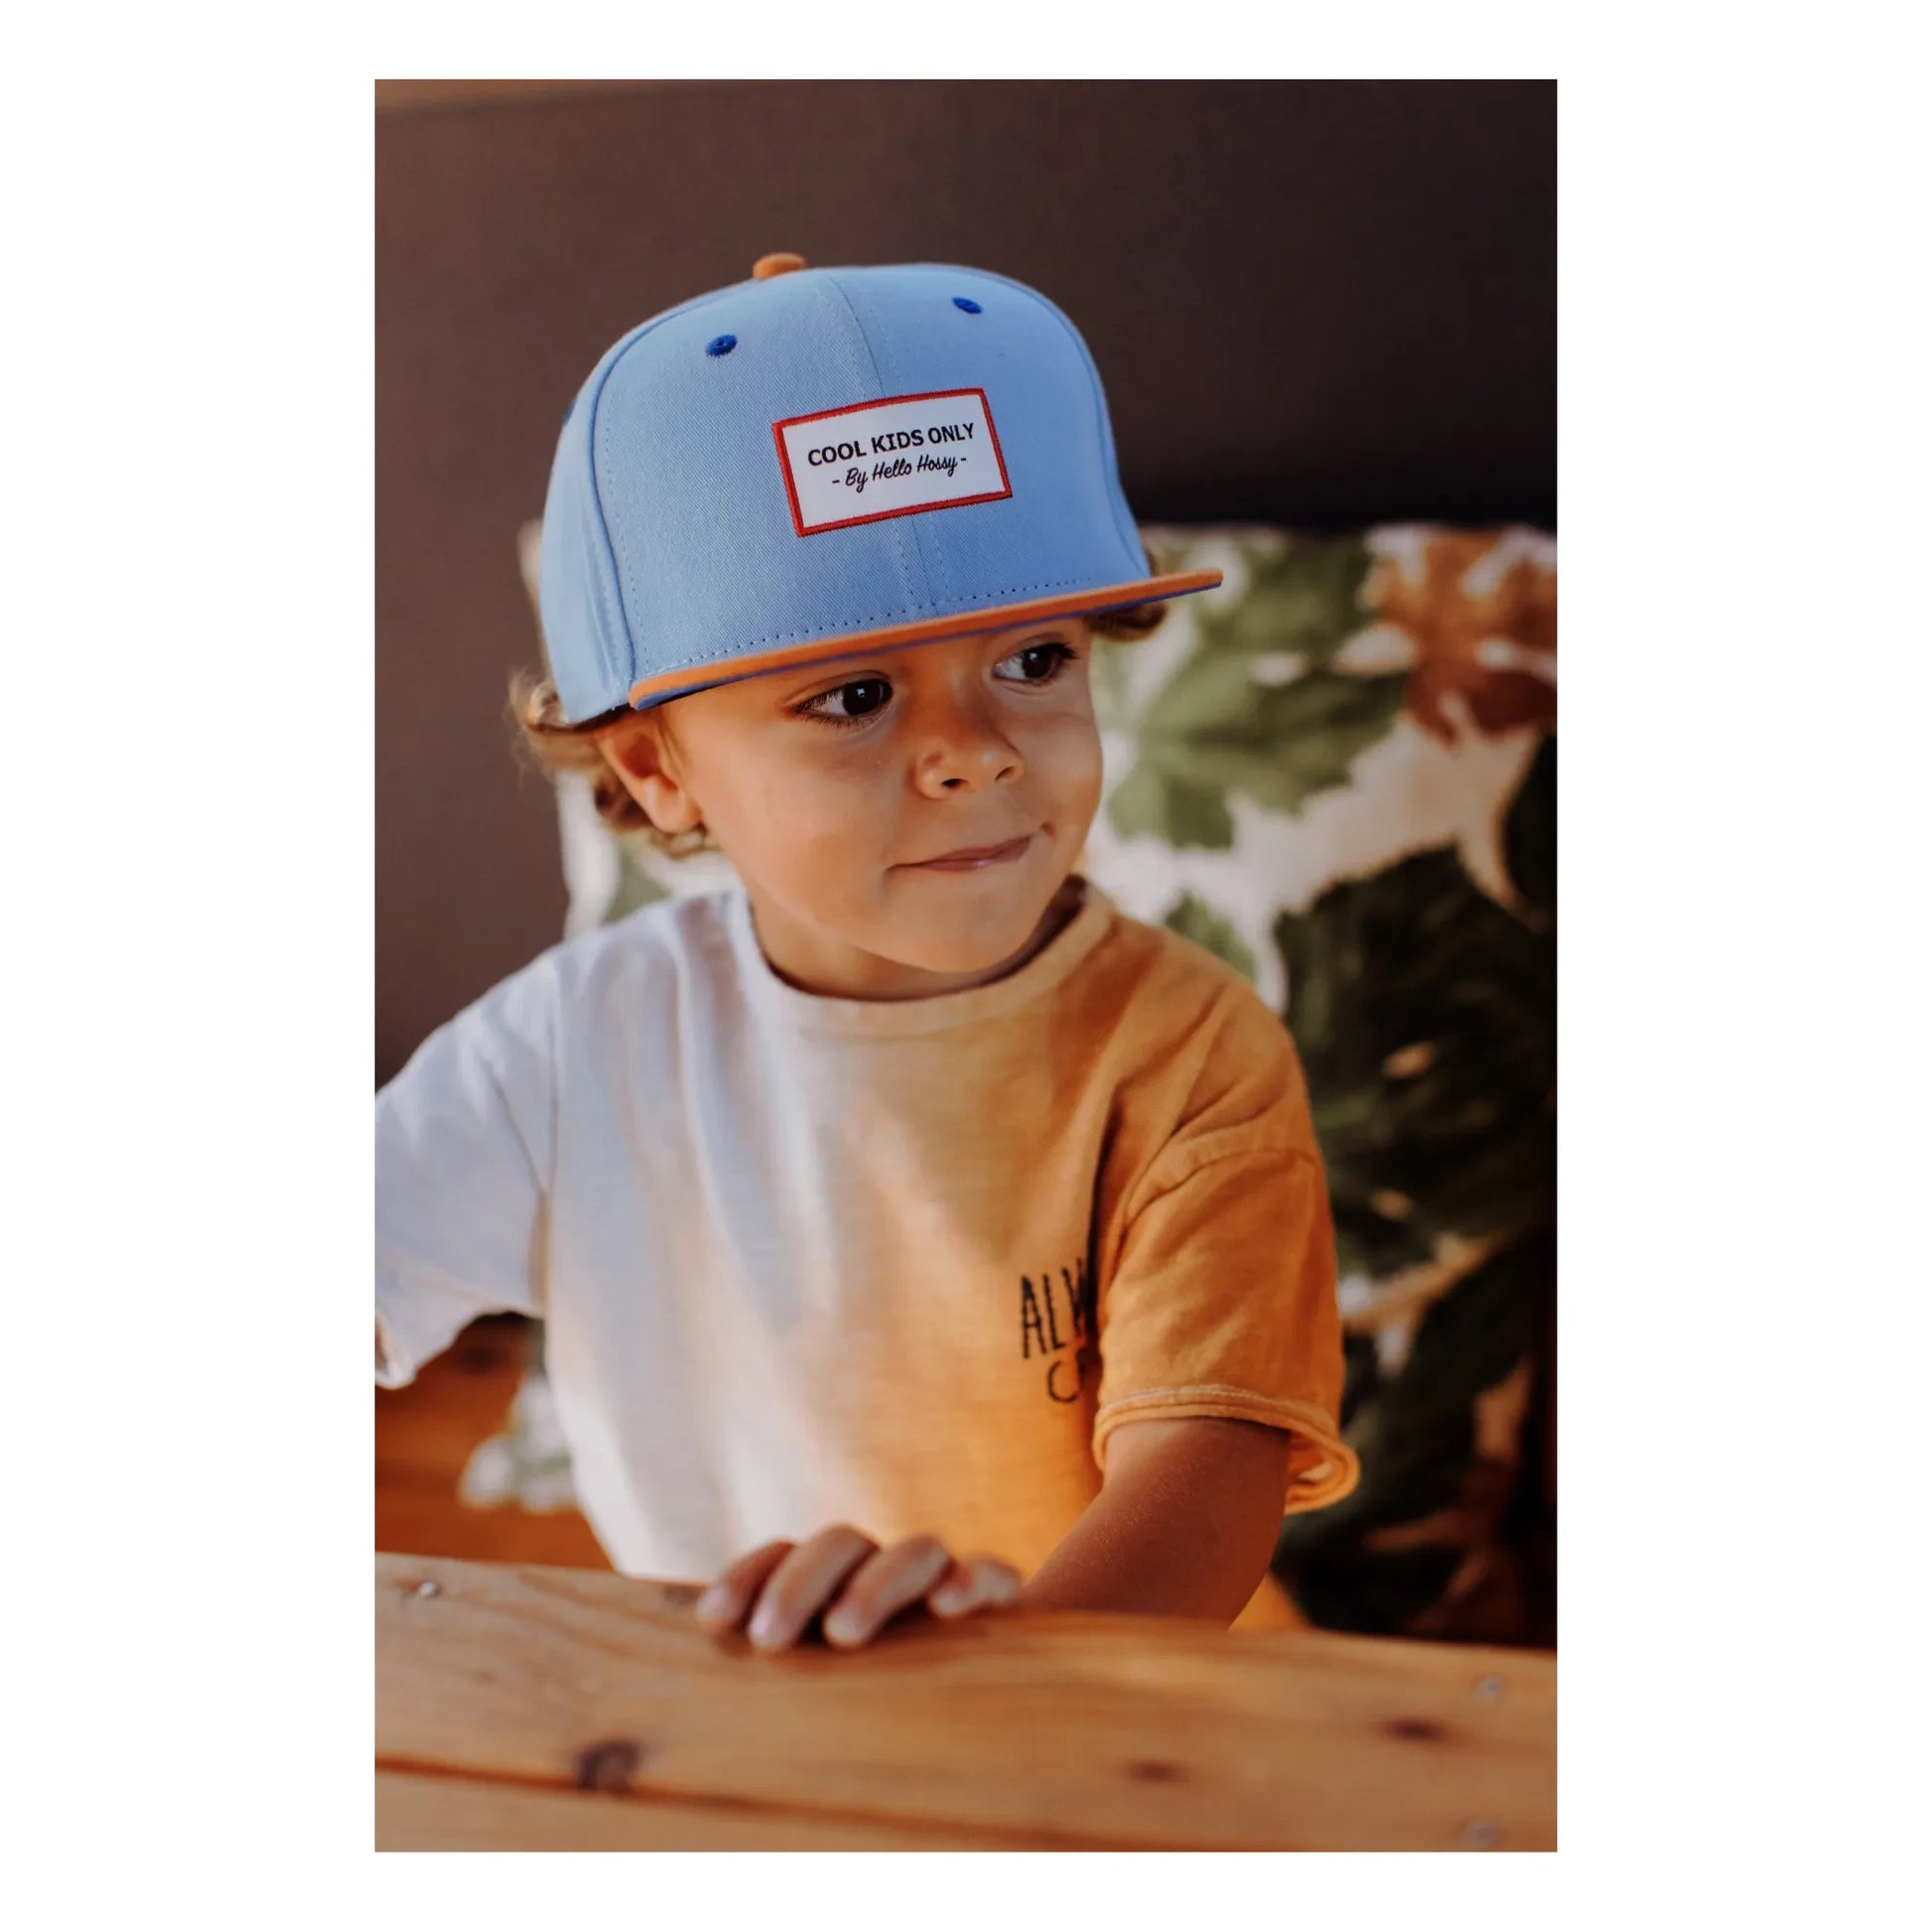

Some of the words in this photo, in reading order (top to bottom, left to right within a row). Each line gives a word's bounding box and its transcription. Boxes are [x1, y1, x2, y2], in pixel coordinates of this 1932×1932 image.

[807, 441, 867, 467] COOL
[871, 430, 924, 455] KIDS
[928, 423, 974, 445] ONLY
[845, 467, 868, 493] By
[872, 458, 912, 481] Hello
[916, 454, 958, 478] Hossy
